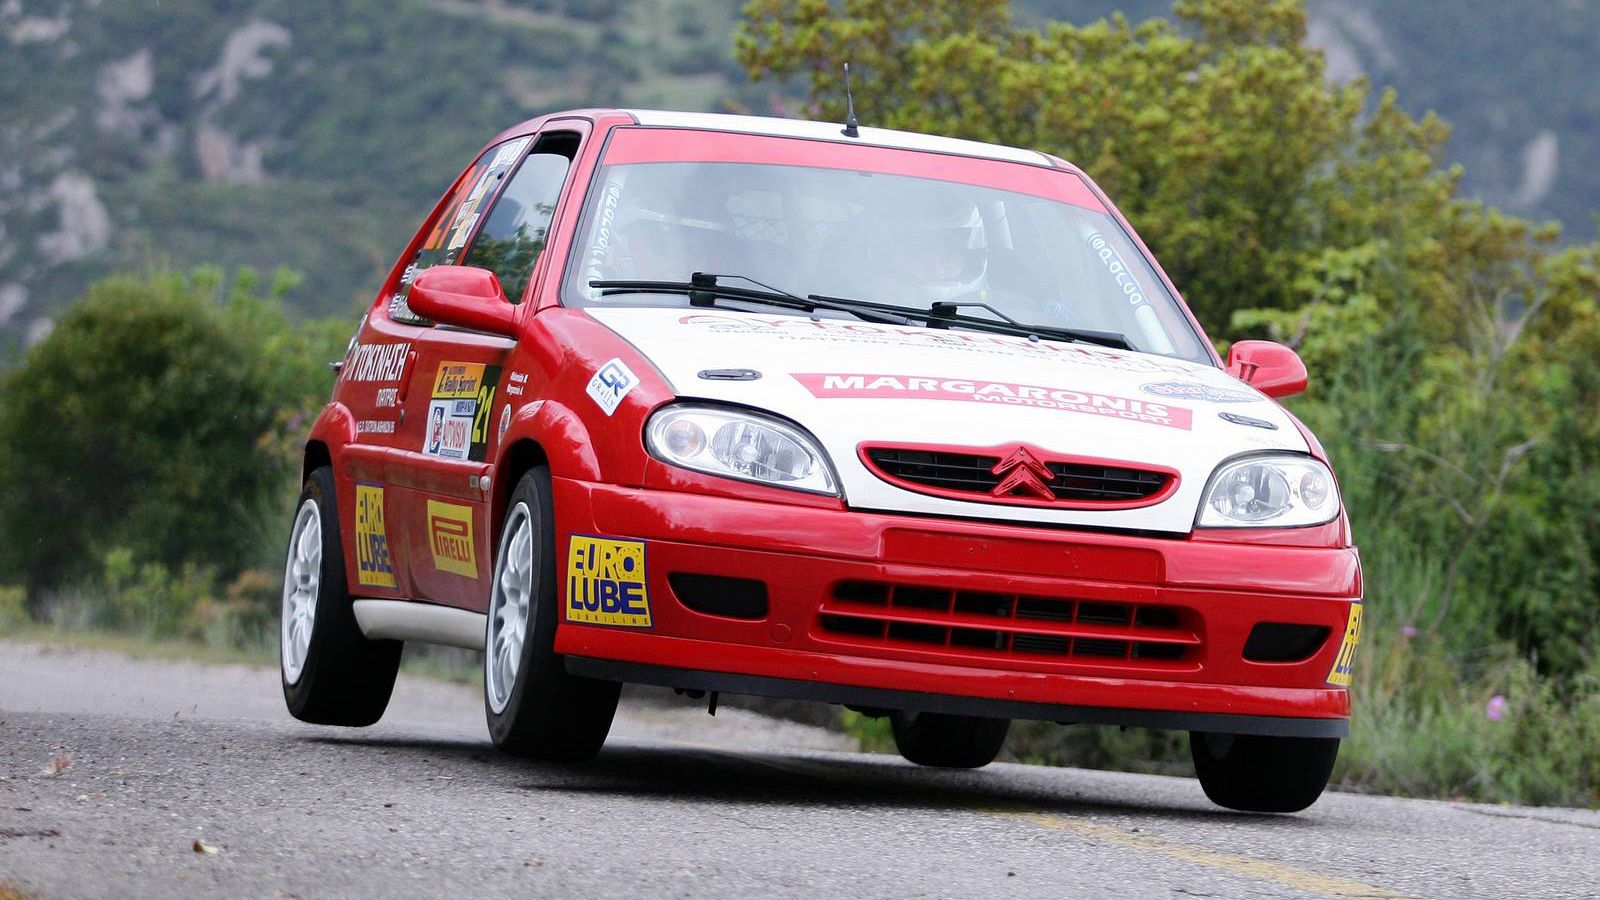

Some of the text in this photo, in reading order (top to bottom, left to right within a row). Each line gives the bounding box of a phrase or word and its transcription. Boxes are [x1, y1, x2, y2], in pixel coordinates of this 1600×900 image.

[599, 363, 630, 397] GR
[823, 374, 1170, 419] MARGARONIS
[472, 385, 497, 444] 21
[973, 393, 1174, 427] MOTORSPORT
[358, 532, 393, 574] LUBE
[431, 515, 471, 563] PIRELLI
[571, 541, 644, 581] EURO
[571, 576, 648, 615] LUBE
